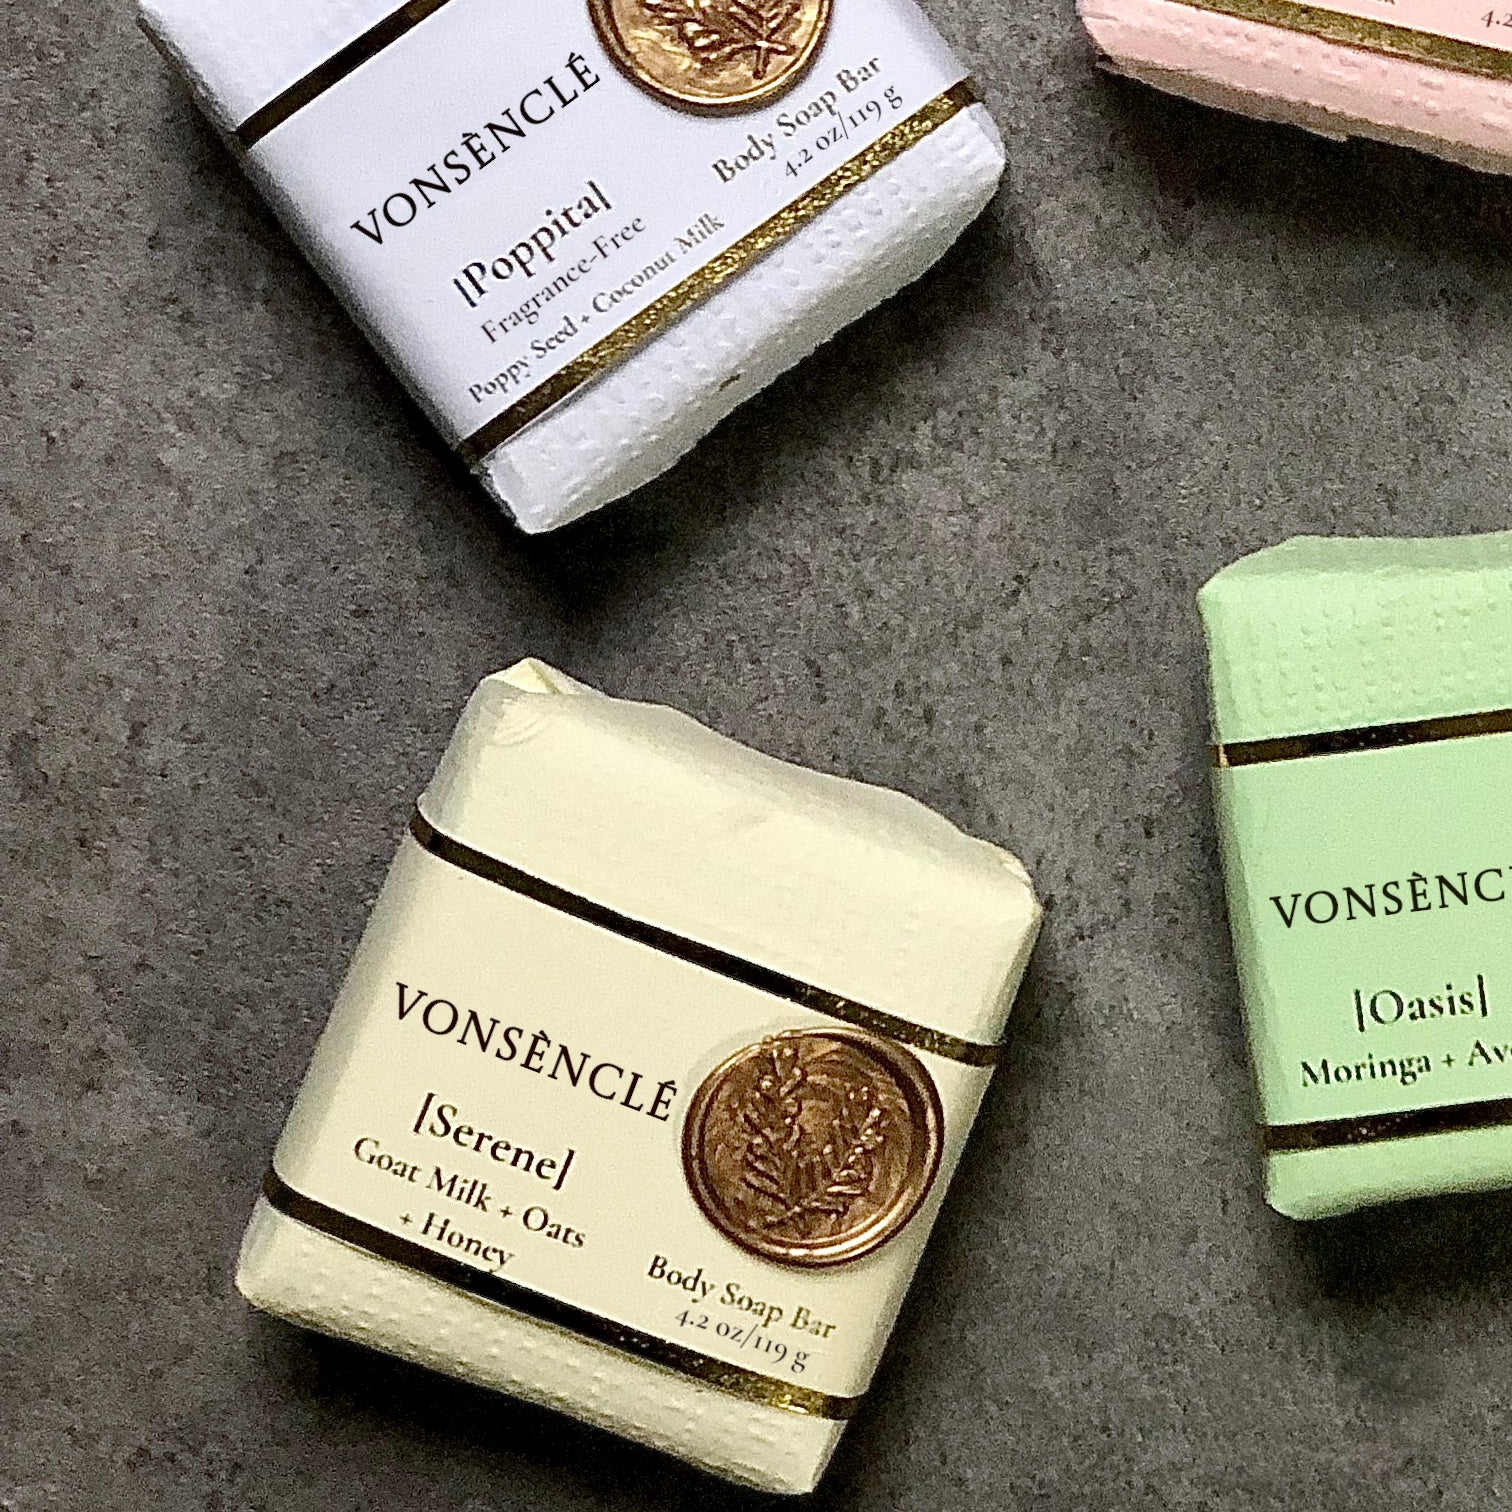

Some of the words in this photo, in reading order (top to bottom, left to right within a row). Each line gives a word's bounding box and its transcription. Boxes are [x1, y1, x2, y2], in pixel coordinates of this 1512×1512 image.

[350, 52, 601, 249] VONSÈNCLÉ
[711, 130, 779, 184] Body
[776, 89, 838, 139] Soap
[836, 54, 884, 93] Bar
[782, 149, 813, 180] 4.2
[812, 102, 884, 153] oz/119
[886, 85, 904, 112] g
[467, 354, 530, 403] Poppy
[529, 317, 579, 361] Seed
[592, 256, 675, 316] Coconut
[673, 213, 725, 253] Milk
[480, 214, 646, 346] Fragrance-Free
[394, 982, 678, 1122] VONSÈNCLÉ
[1299, 1055, 1433, 1088] Moringa
[353, 1136, 422, 1184] Goat
[426, 1165, 491, 1214] Milk
[522, 1205, 586, 1249] Oats
[420, 1211, 514, 1274] Honey
[647, 1254, 715, 1304] Body
[720, 1281, 784, 1328] Soap
[790, 1305, 837, 1341] Bar
[674, 1308, 710, 1332] 4.2
[716, 1319, 789, 1364] oz/119
[793, 1348, 810, 1374] g
